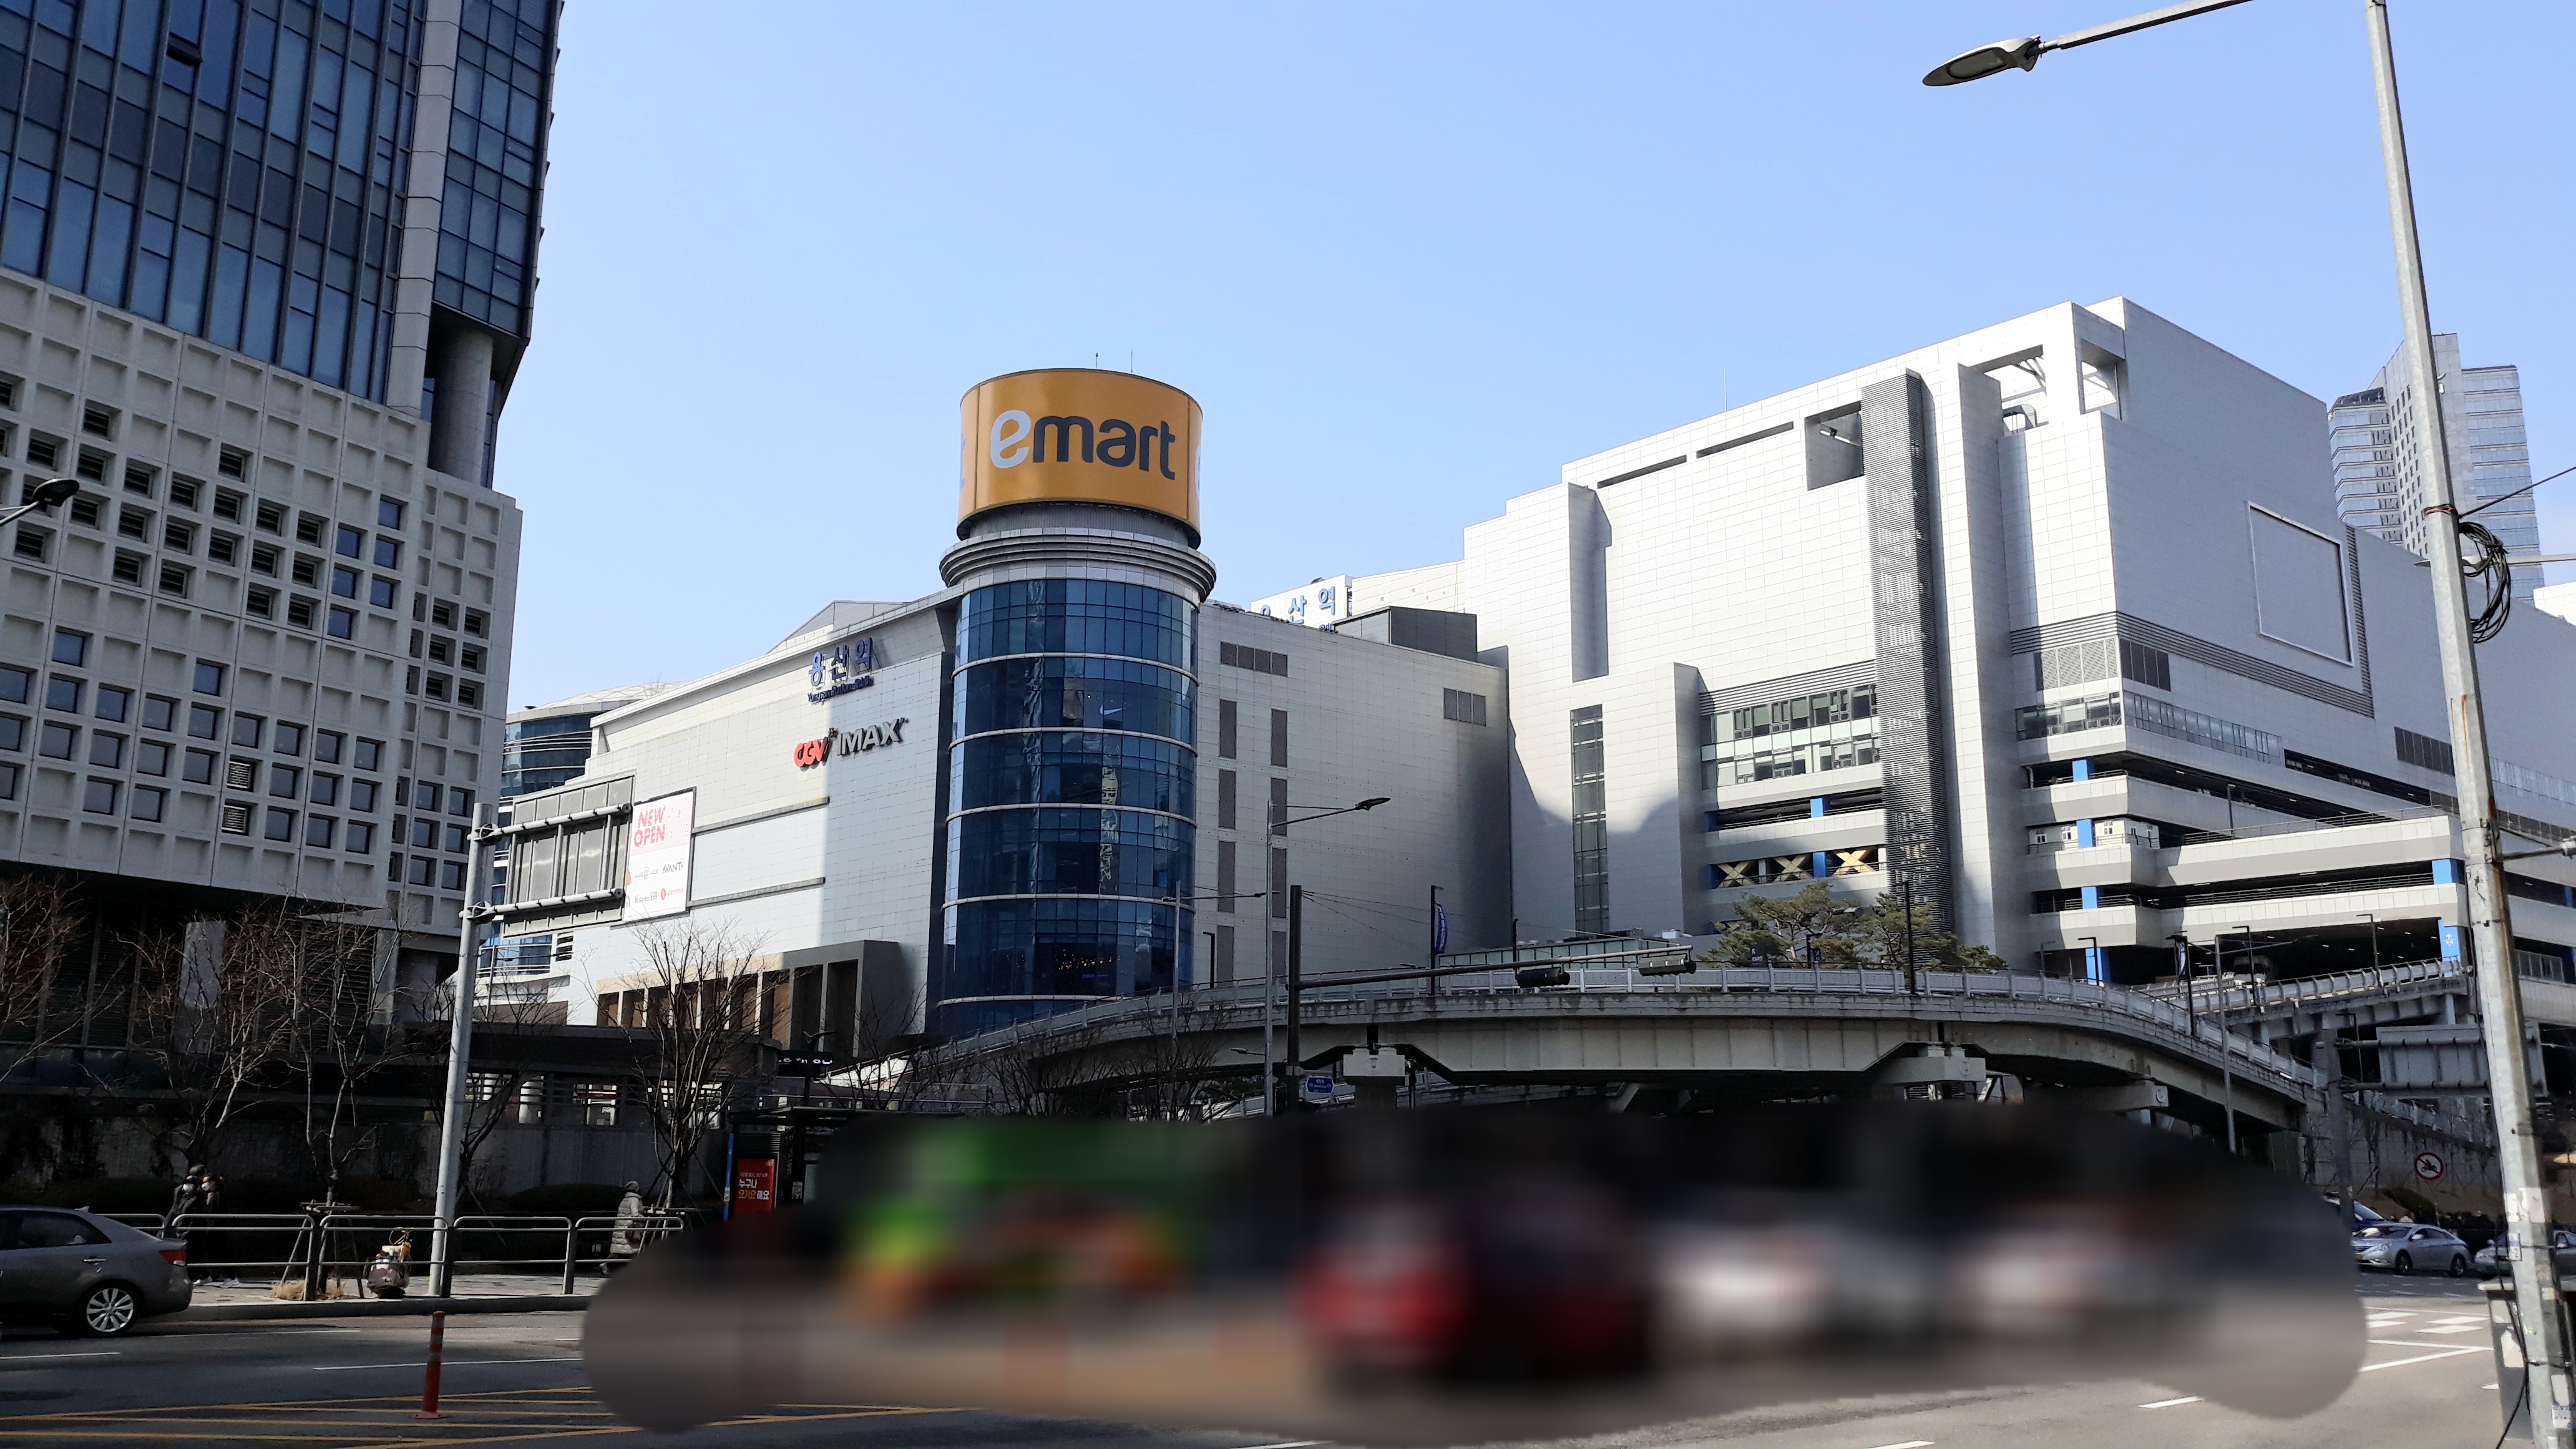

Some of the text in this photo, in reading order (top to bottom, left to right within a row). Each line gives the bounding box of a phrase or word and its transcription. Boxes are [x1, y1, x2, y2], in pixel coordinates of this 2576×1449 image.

[990, 409, 1176, 480] emart
[809, 637, 872, 686] 용산역
[794, 718, 903, 768] CGV IMAX
[634, 824, 666, 847] OPEN
[637, 806, 666, 829] NEW
[739, 1179, 758, 1189] 누구나
